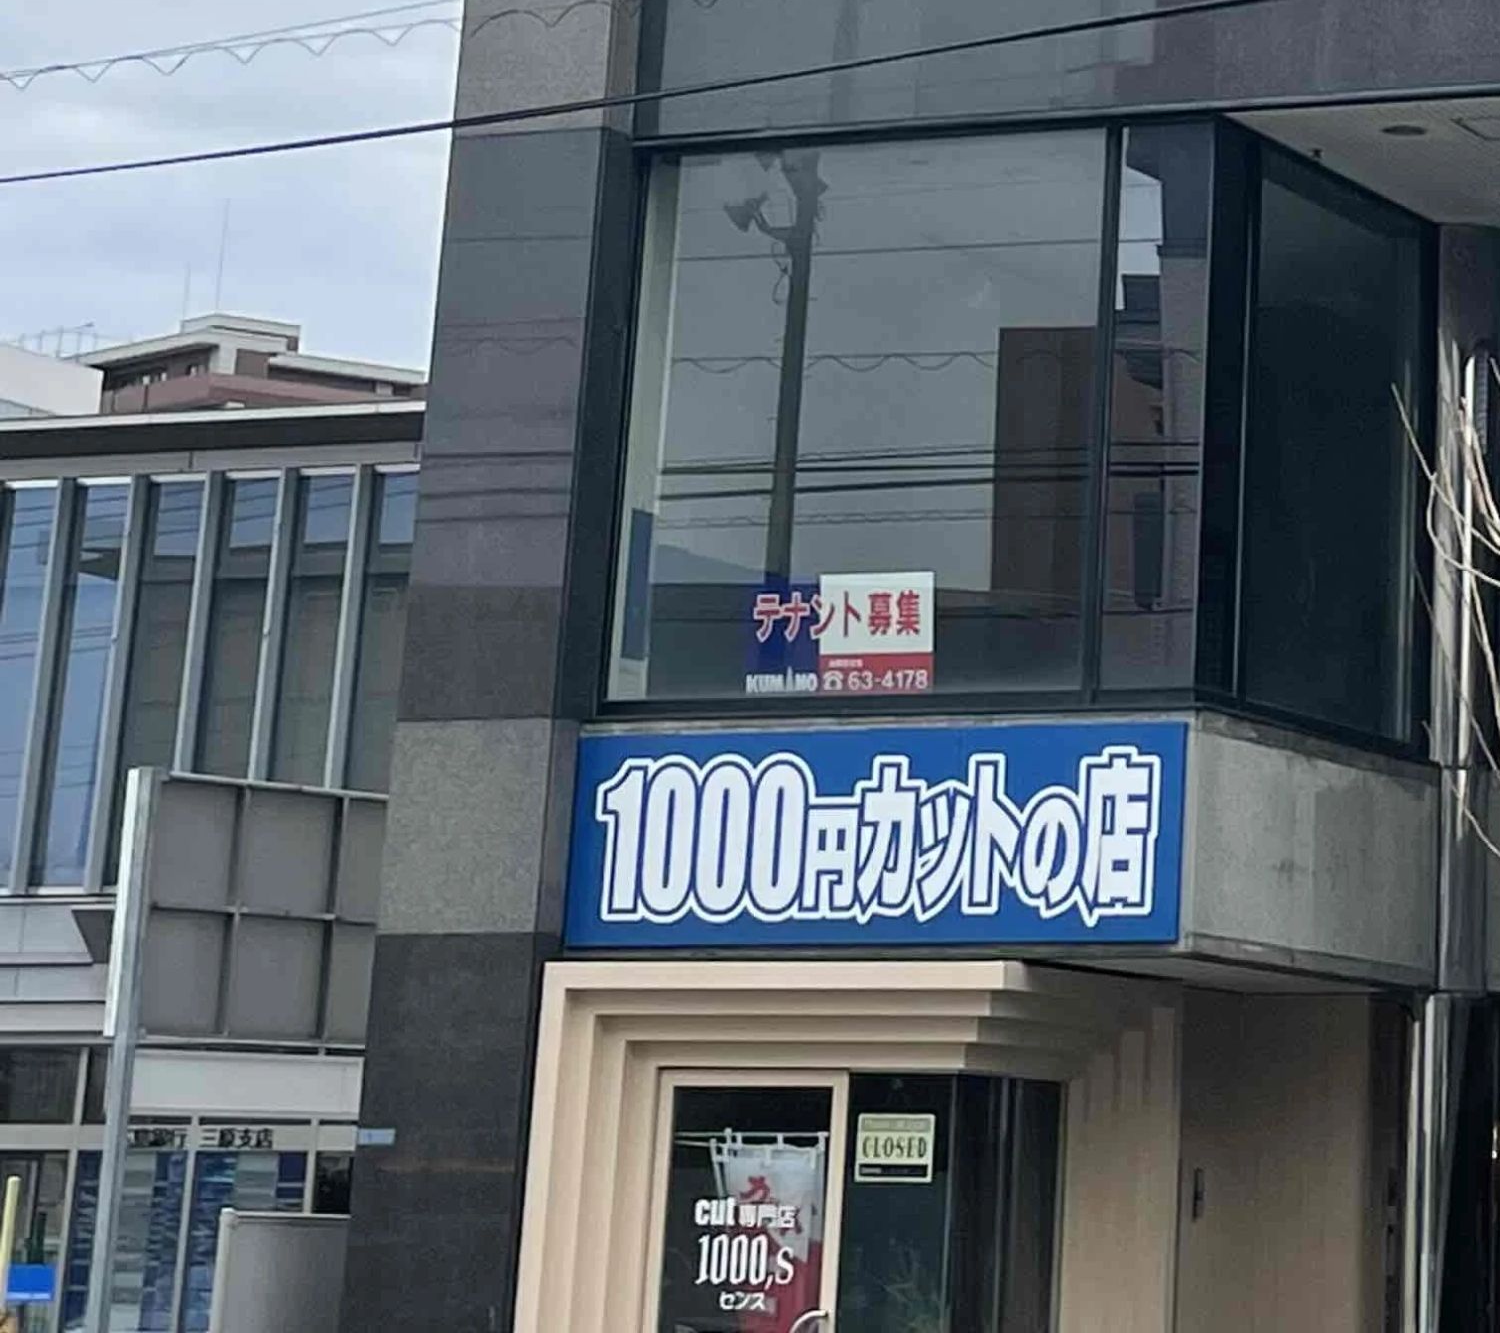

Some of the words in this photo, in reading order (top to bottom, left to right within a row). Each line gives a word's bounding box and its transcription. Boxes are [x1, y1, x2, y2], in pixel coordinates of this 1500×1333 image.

[753, 589, 921, 643] テナント募集
[848, 669, 928, 691] 63-4178
[597, 746, 1160, 927] 1000円カットの店
[862, 1135, 927, 1159] CLOSED
[719, 1291, 767, 1310] センス
